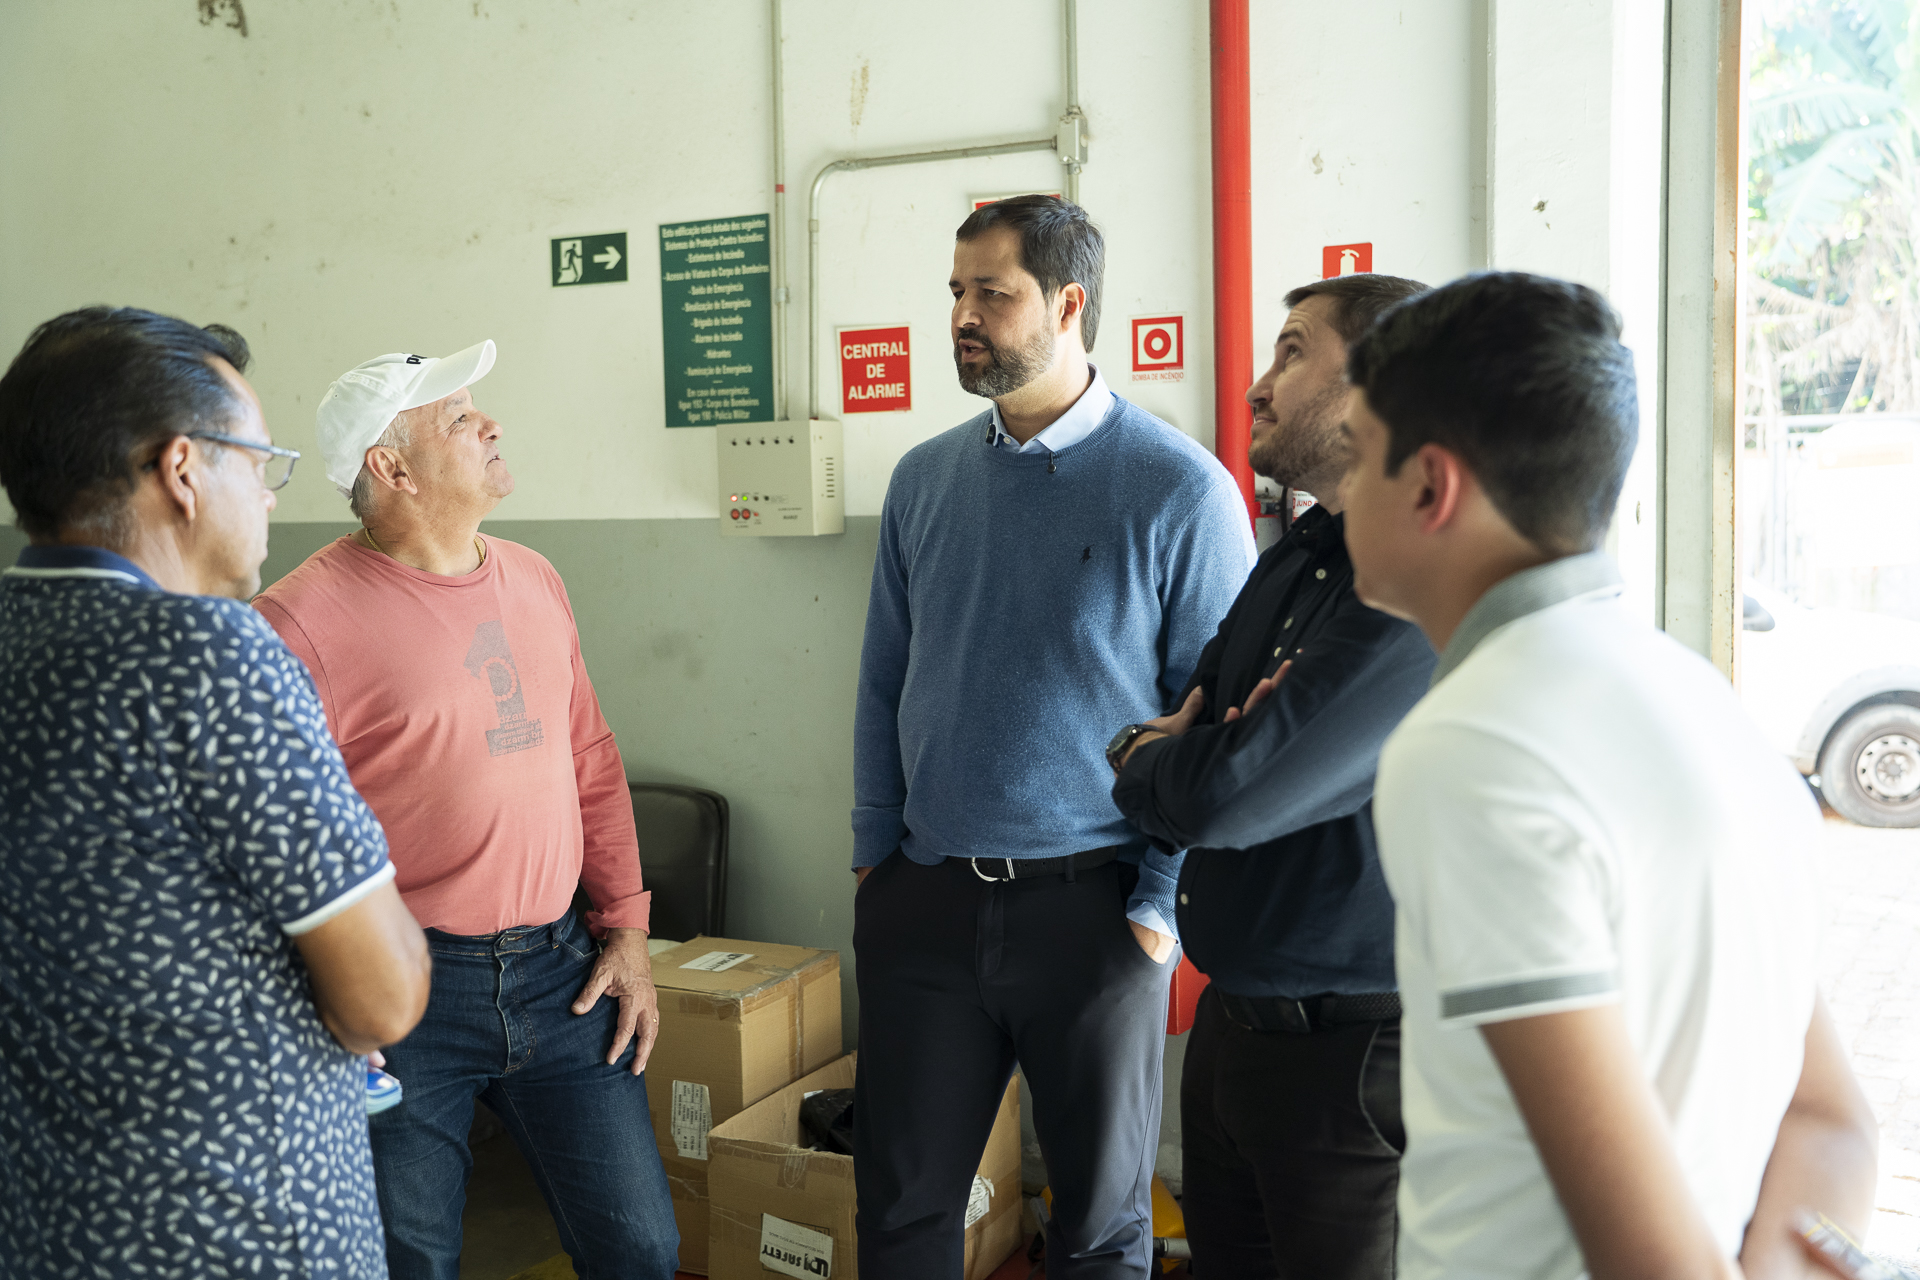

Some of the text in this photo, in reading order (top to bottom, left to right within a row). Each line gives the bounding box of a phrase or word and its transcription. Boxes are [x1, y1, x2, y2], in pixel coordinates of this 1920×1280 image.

[843, 341, 908, 360] CENTRAL
[866, 363, 886, 379] DE
[1160, 372, 1184, 380] INCÊNDIO
[848, 382, 906, 400] ALARME
[762, 1244, 802, 1266] SAFETY
